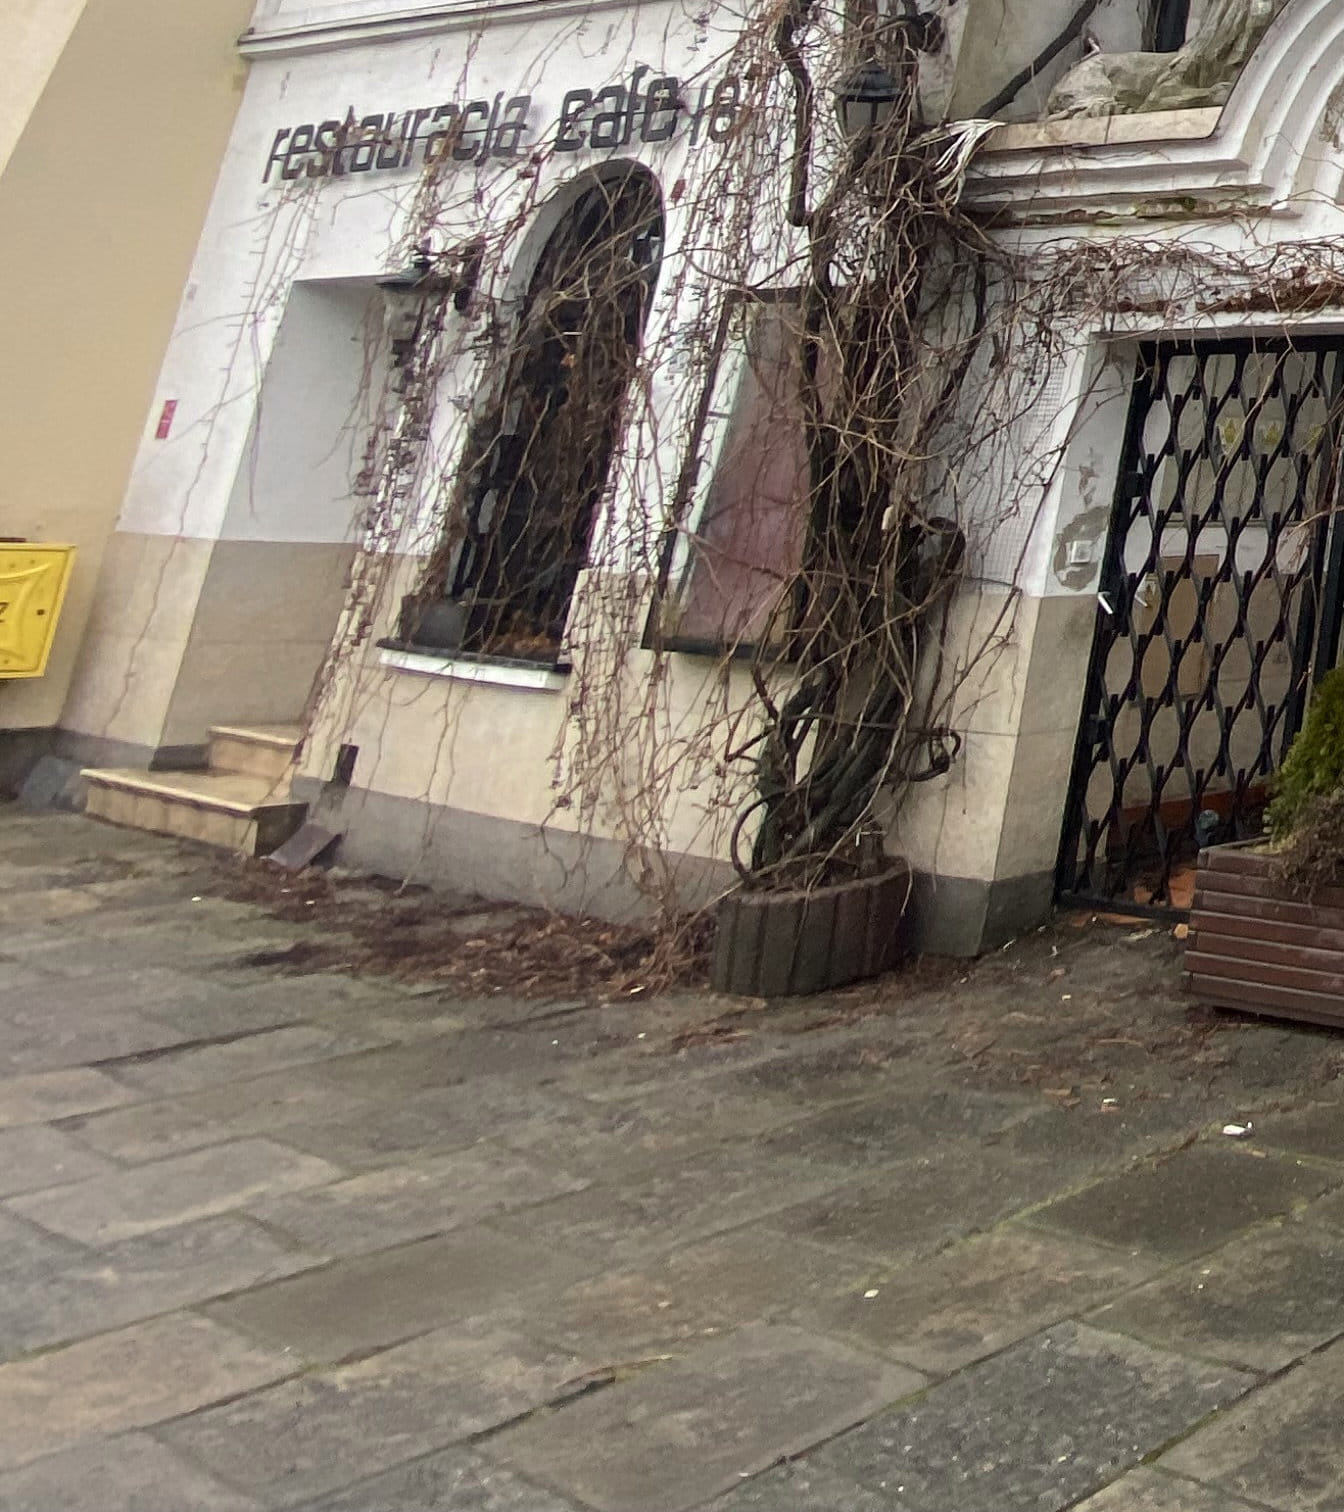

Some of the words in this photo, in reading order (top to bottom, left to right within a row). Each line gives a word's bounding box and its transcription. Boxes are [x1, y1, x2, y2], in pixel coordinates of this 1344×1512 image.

[262, 91, 532, 184] restauracja
[554, 64, 679, 152] cafe
[689, 77, 741, 146] 18
